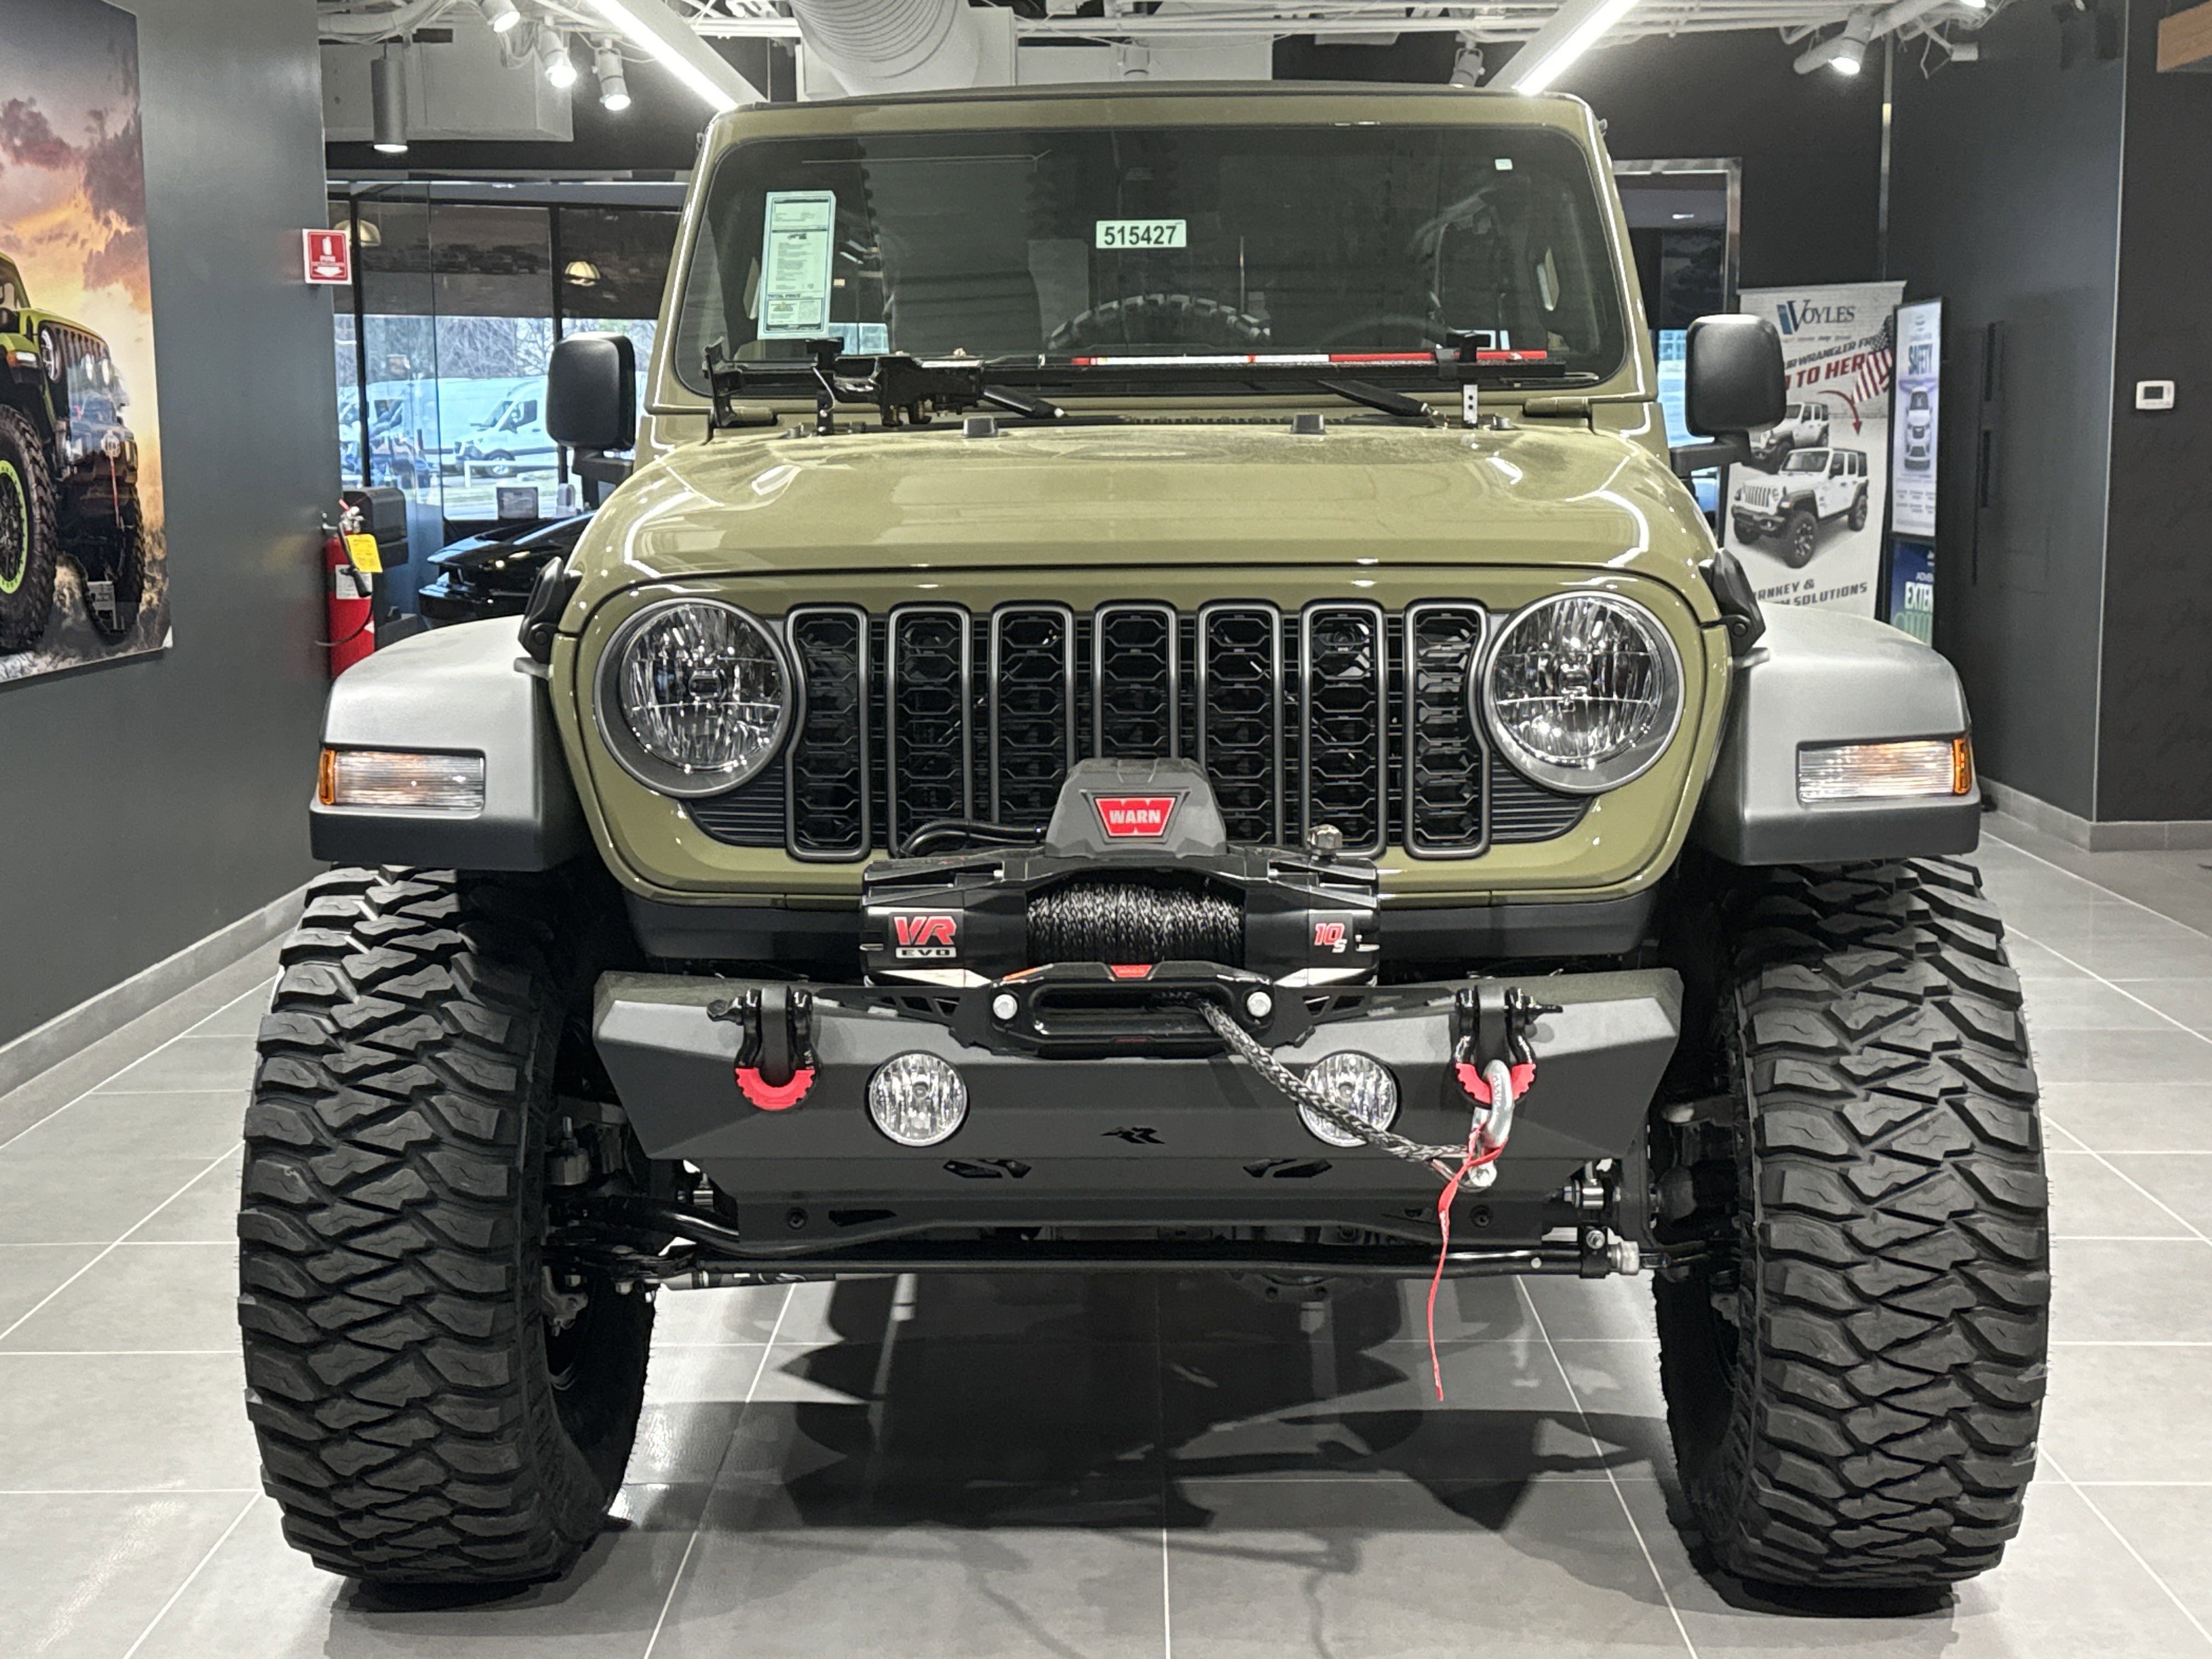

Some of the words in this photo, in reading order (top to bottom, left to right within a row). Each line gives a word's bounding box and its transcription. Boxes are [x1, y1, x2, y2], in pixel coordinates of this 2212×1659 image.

[1104, 225, 1177, 245] 515427
[1787, 299, 1856, 332] VOYLES
[1797, 366, 1820, 388] TO
[1825, 353, 1865, 380] HER
[1754, 581, 1800, 601] RNKEY
[1793, 582, 1867, 606] SOLUTIONS
[1109, 809, 1161, 824] WARN
[894, 916, 957, 945] VR
